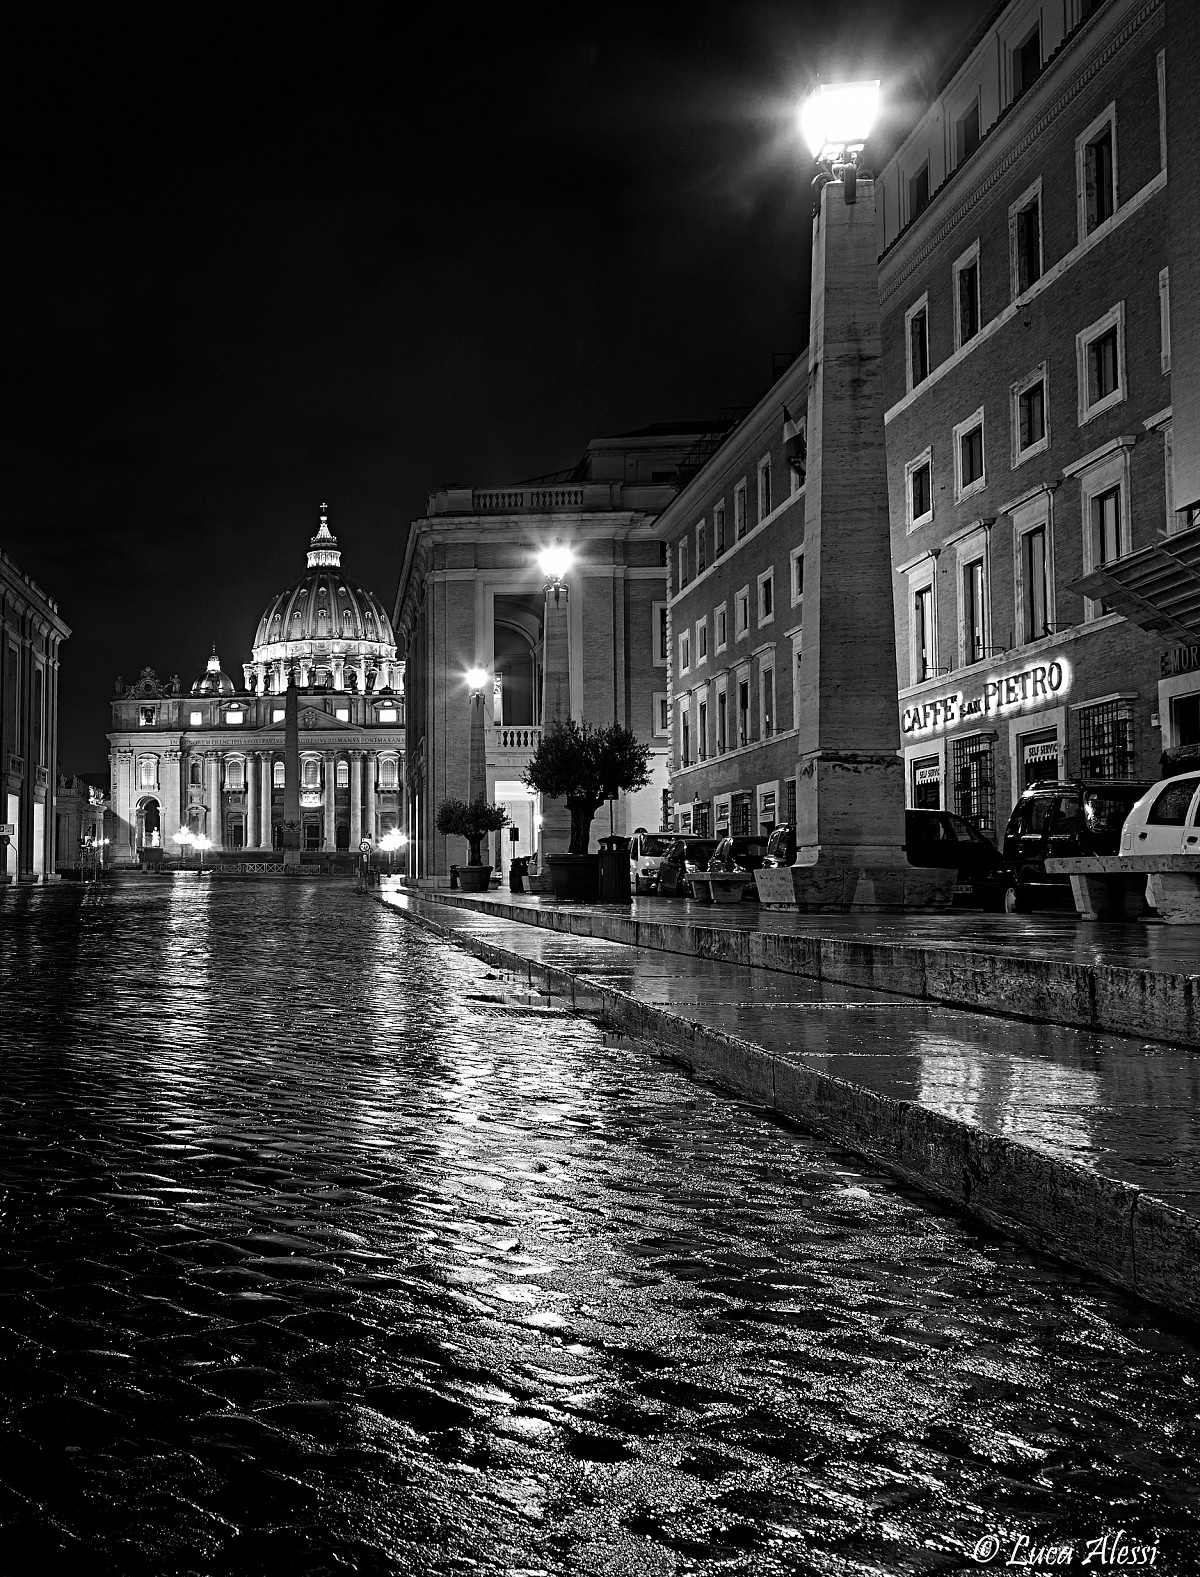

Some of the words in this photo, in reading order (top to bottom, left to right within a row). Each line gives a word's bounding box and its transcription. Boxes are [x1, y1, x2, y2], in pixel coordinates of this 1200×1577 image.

[983, 662, 1063, 715] PIETRO
[1028, 746, 1039, 757] SELF
[919, 770, 928, 779] SELF
